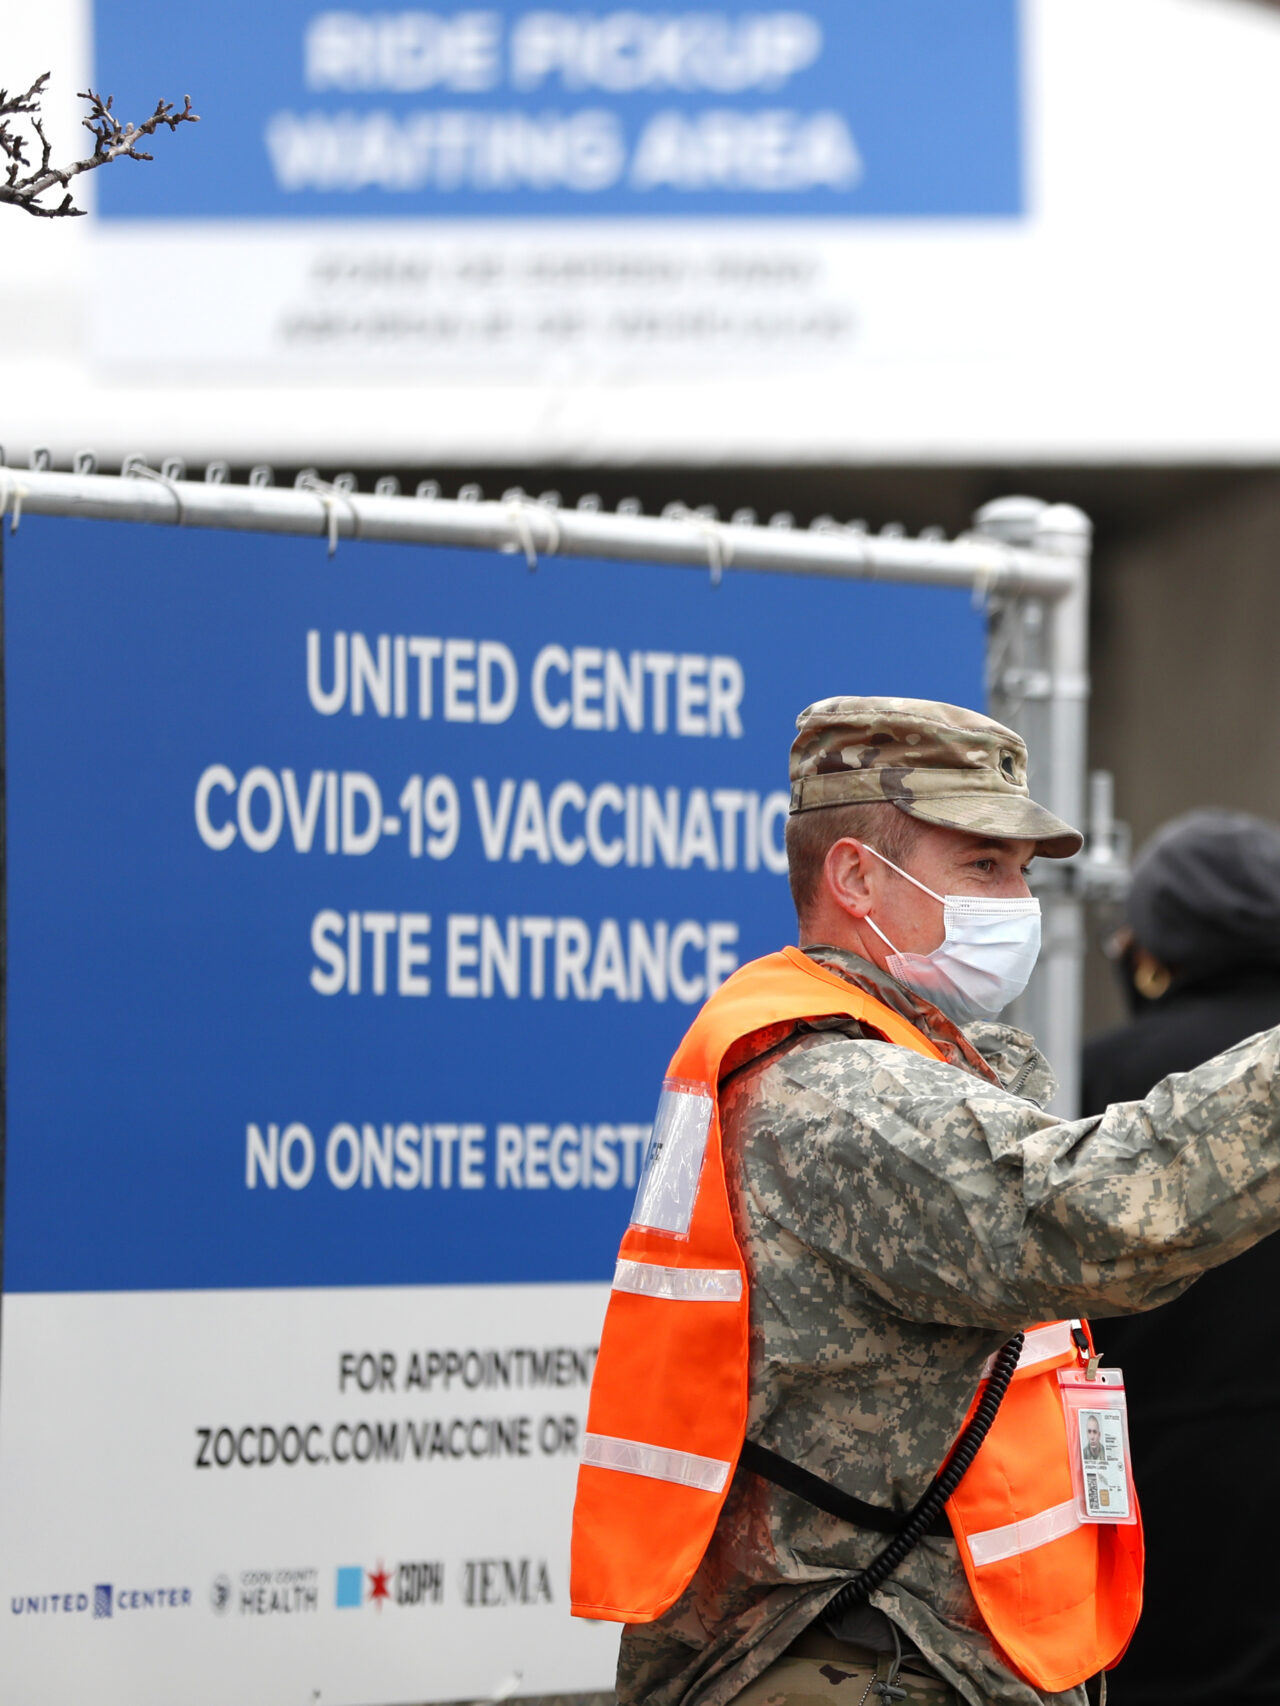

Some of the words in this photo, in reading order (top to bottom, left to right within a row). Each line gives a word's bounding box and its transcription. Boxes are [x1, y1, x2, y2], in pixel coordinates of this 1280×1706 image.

[303, 11, 501, 93] RIDE
[509, 11, 823, 94] PICKUP
[264, 108, 628, 192] WAITING
[631, 109, 863, 192] AREA
[306, 629, 519, 725] UNITED
[530, 643, 745, 739] CENTER
[194, 763, 461, 861] COVID-19
[310, 908, 431, 997] SITE
[446, 913, 738, 1003] ENTRANCE
[245, 1122, 316, 1190] NO
[325, 1122, 486, 1190] ONSITE
[495, 1123, 654, 1190] REGIST
[338, 1350, 398, 1394] FOR
[193, 1414, 532, 1470] ZOCDOC.COM/VACCINE
[537, 1413, 580, 1457] OR
[10, 1592, 89, 1615] UNITED
[116, 1586, 192, 1610] CENTER
[239, 1586, 318, 1616] HEALTH
[462, 1557, 554, 1608] IEMA
